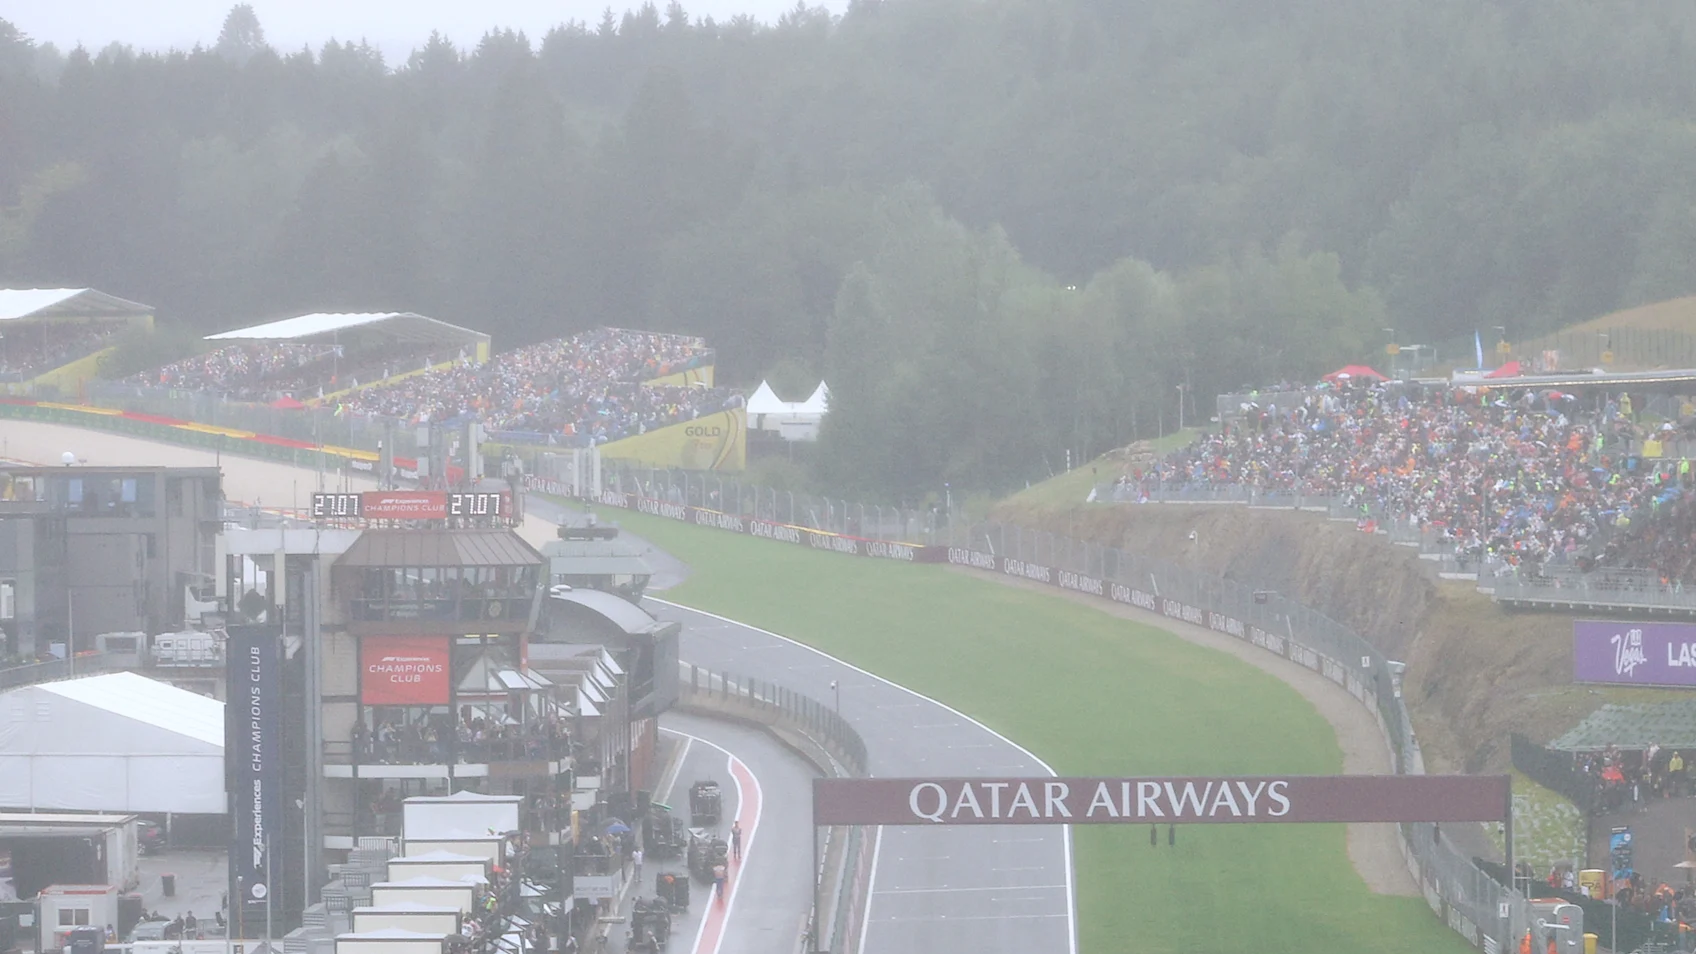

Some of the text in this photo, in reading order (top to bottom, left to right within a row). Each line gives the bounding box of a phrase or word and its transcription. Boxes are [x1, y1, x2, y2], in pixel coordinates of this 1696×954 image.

[685, 426, 720, 437] GOLD
[314, 495, 358, 516] 27.07
[364, 505, 418, 513] CHAMPIONS
[451, 494, 501, 515] 27.07
[637, 499, 686, 520] QATAR AIRWAYS
[717, 514, 743, 532] AIRWAYS
[750, 520, 800, 543] QATAR AIRWAYS
[948, 547, 995, 569] QATAR AIRWAYS
[1004, 558, 1050, 582] QATAR AIRWAYS
[1059, 571, 1102, 595] QATAR AIRWAYS
[251, 646, 260, 682] CLUB
[369, 664, 443, 673] CHAMPIONS
[390, 674, 421, 683] CLUB
[251, 687, 262, 772] CHAMPIONS
[253, 779, 262, 845] Experiences
[909, 780, 1291, 823] QATAR AIRWAYS
